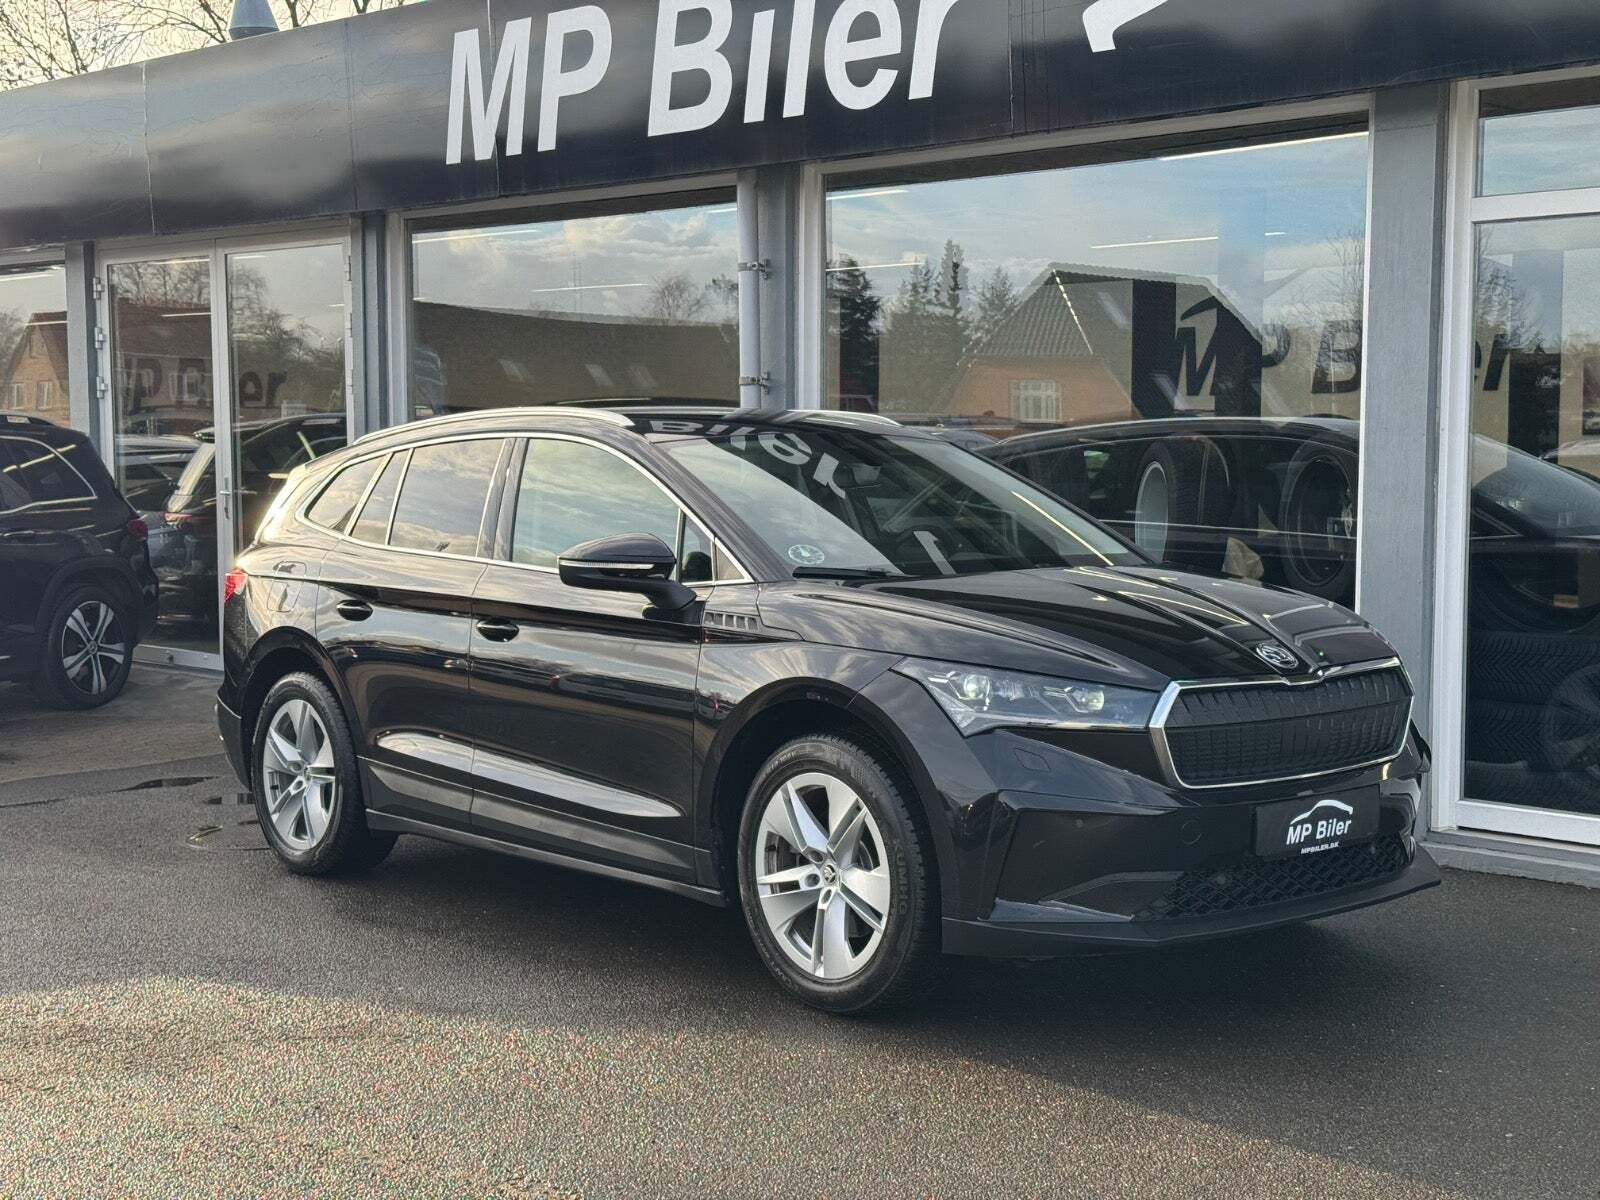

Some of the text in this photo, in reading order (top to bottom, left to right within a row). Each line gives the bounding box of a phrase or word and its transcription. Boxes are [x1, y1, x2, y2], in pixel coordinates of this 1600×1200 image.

[445, 0, 960, 165] MP Biler
[1286, 818, 1352, 845] MP Biler
[1300, 841, 1340, 854] MPBILER.DK
